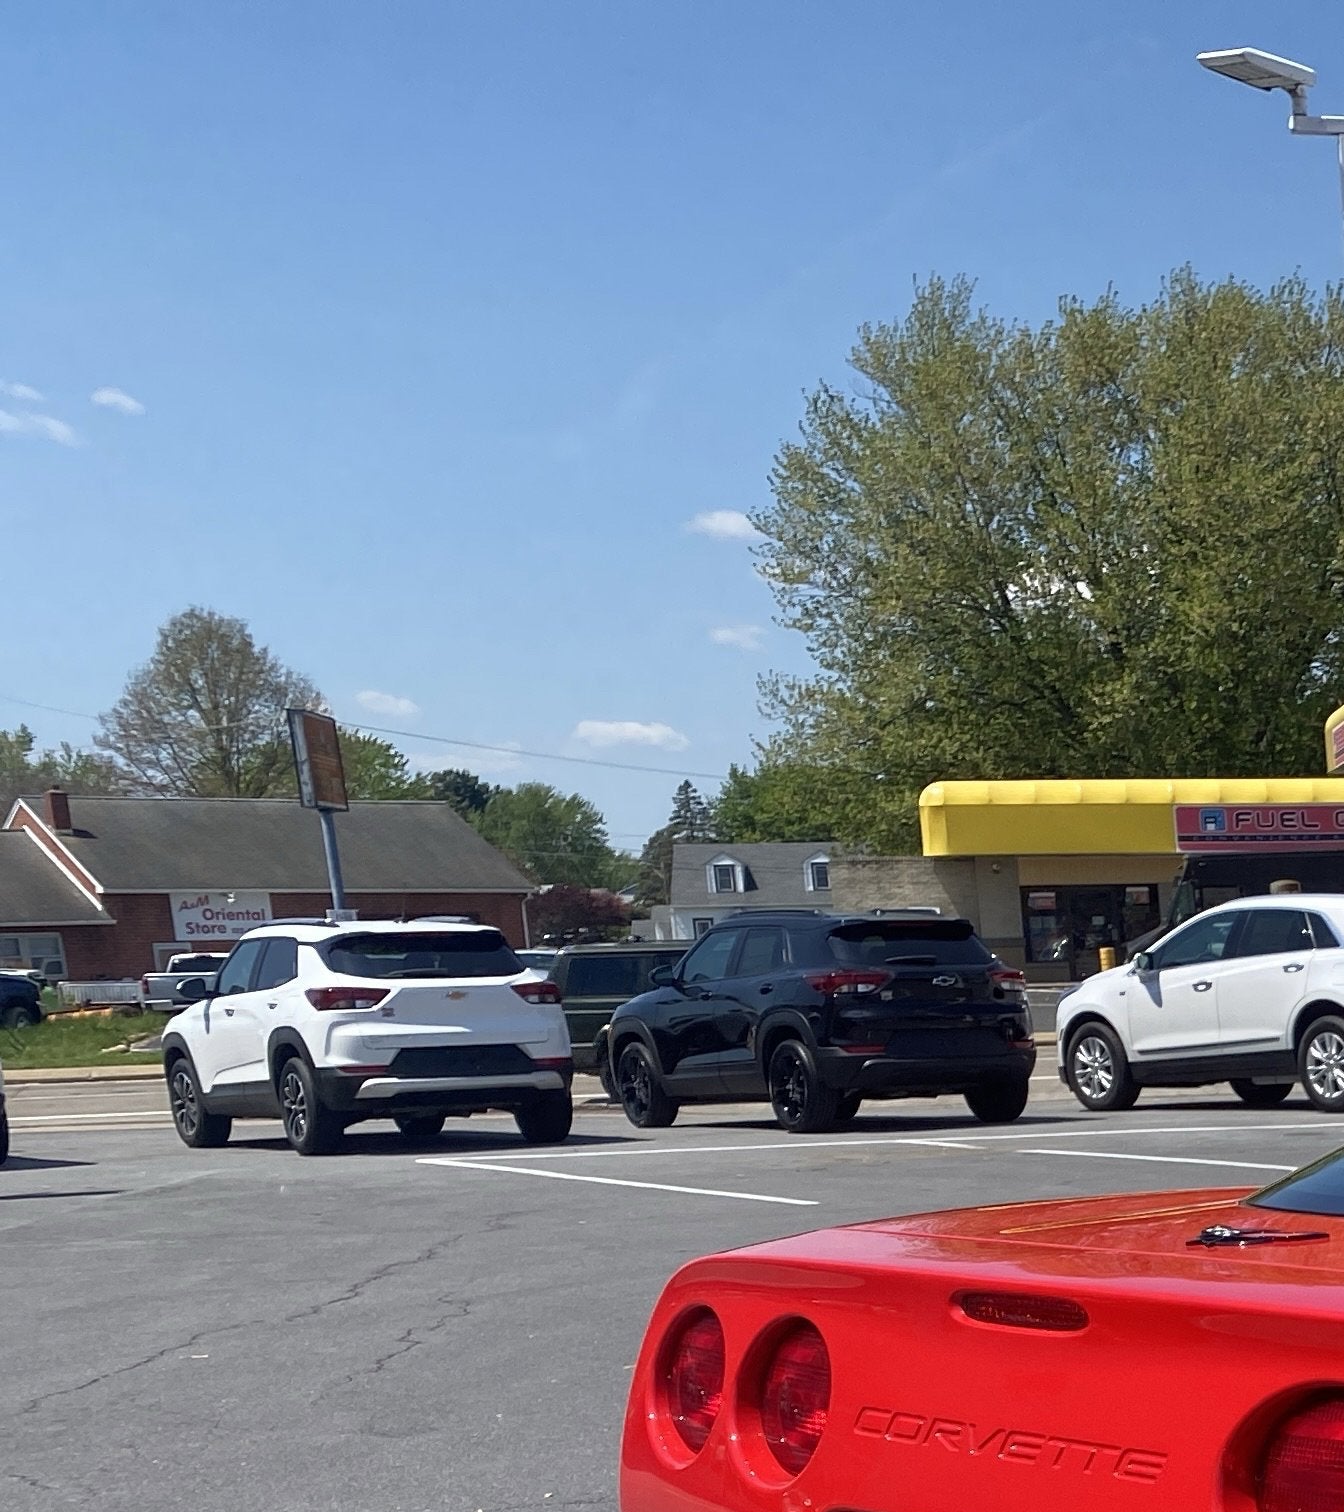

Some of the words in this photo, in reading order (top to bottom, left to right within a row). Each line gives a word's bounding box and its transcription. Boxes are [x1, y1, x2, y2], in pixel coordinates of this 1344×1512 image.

[1234, 810, 1320, 830] FUEL
[202, 908, 266, 921] Oriental
[186, 921, 227, 935] Store
[854, 1406, 1168, 1485] CORVETTE
